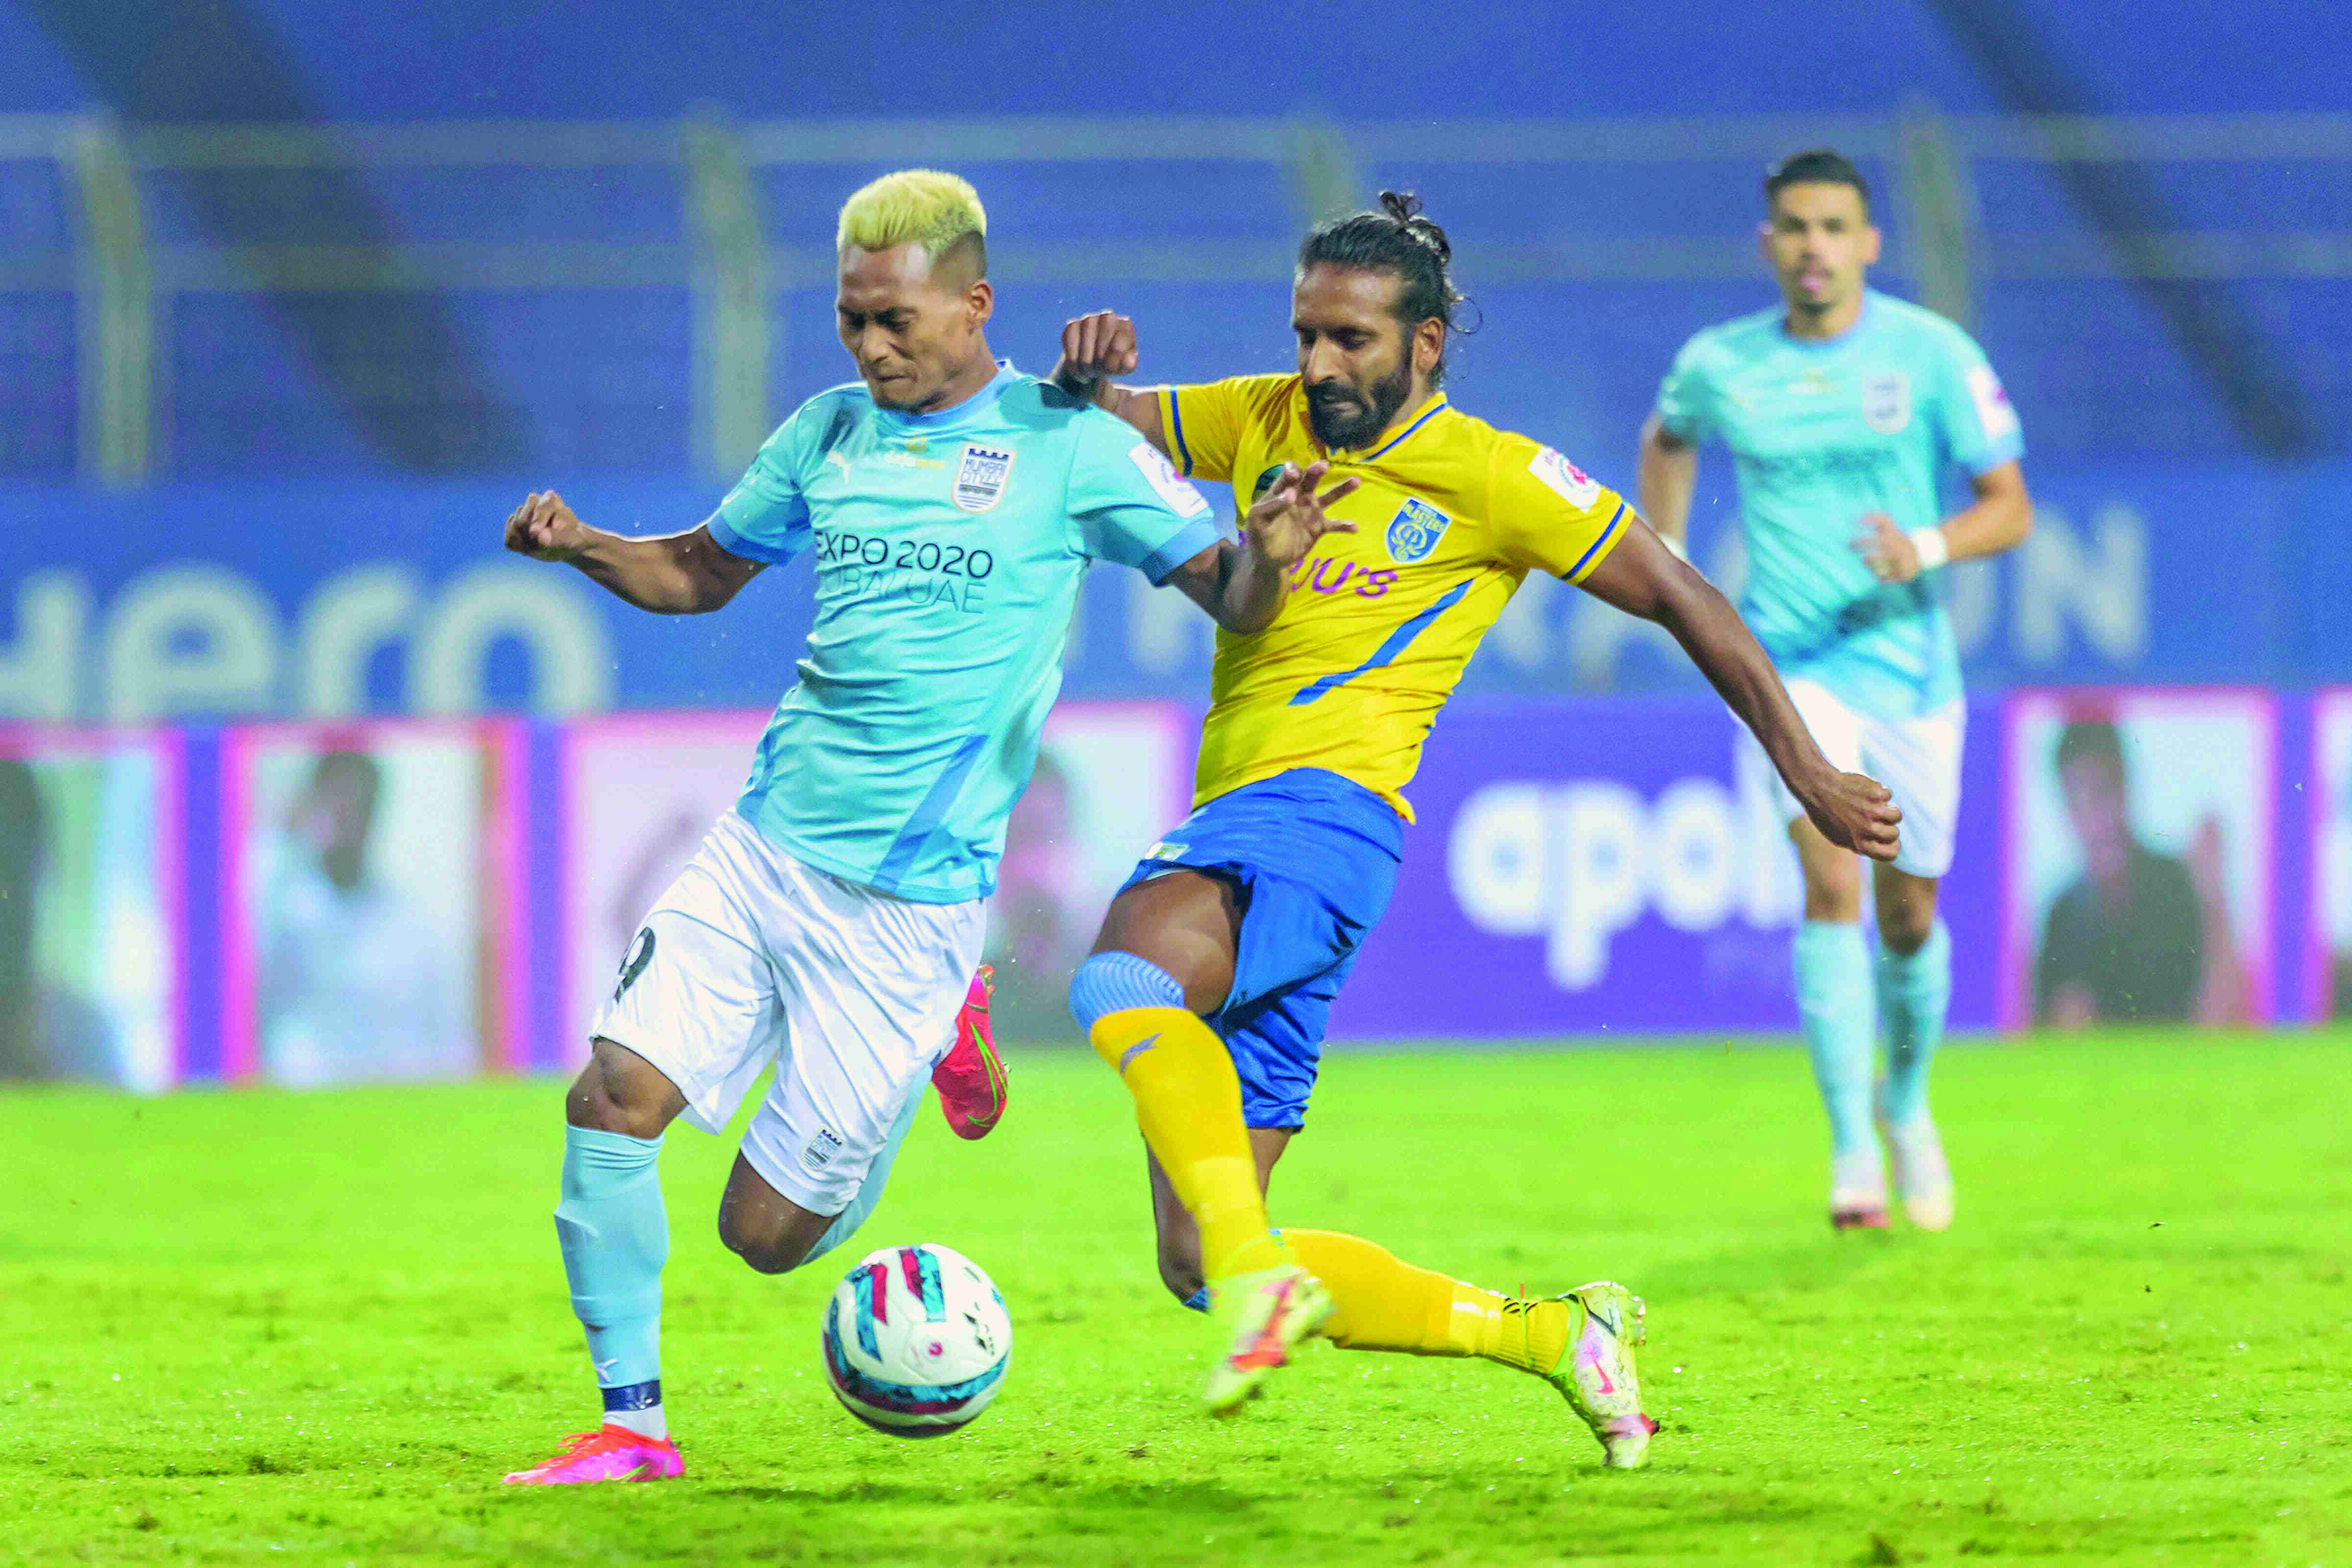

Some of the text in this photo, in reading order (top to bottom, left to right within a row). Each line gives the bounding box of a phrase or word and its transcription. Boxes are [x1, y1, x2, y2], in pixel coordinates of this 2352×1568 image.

[963, 458, 1007, 475] MUMBAI
[815, 531, 993, 579] EXPO 2020
[1448, 737, 1808, 989] apol
[614, 927, 656, 1004] 9
